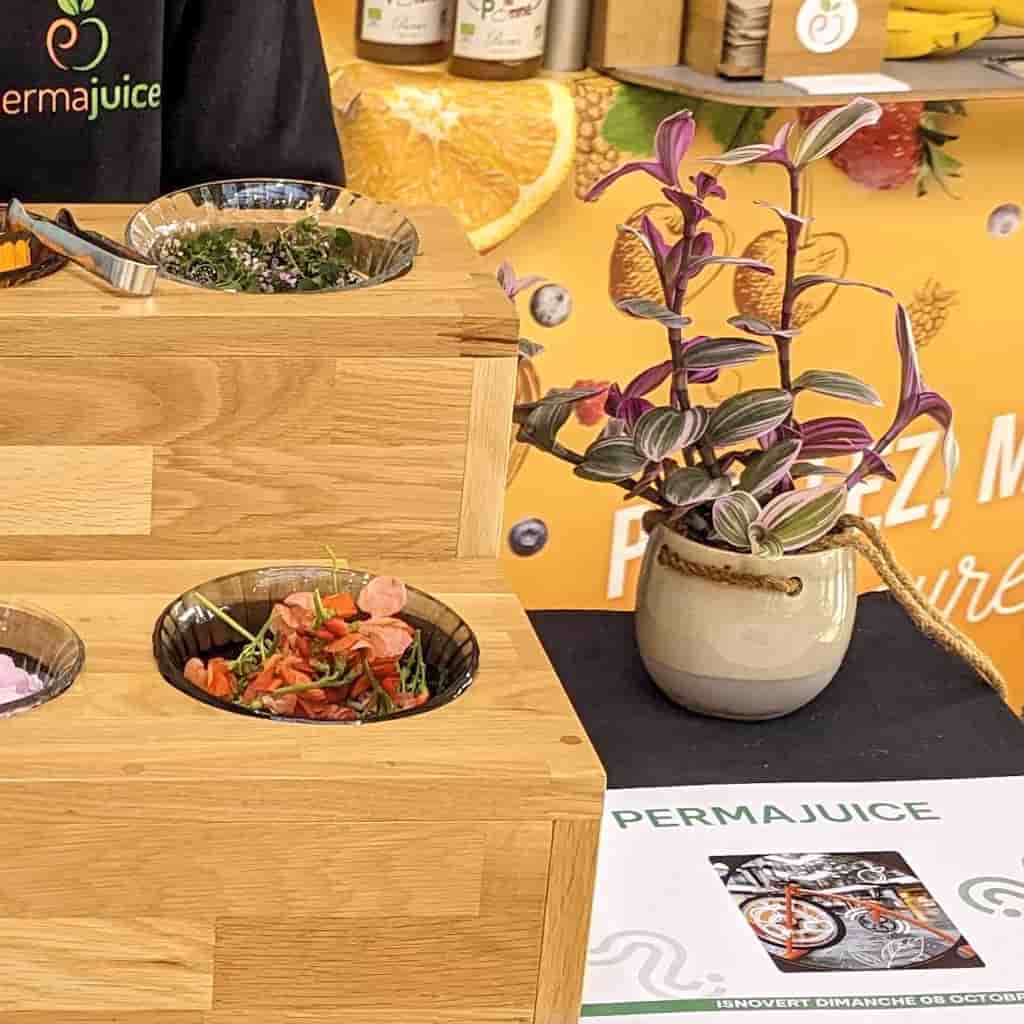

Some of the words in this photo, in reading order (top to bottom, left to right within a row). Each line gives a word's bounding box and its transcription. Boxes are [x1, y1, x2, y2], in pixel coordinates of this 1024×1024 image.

[610, 800, 943, 830] PERMAJUICE
[815, 996, 918, 1009] DIMANCHE
[919, 995, 946, 1007] 08
